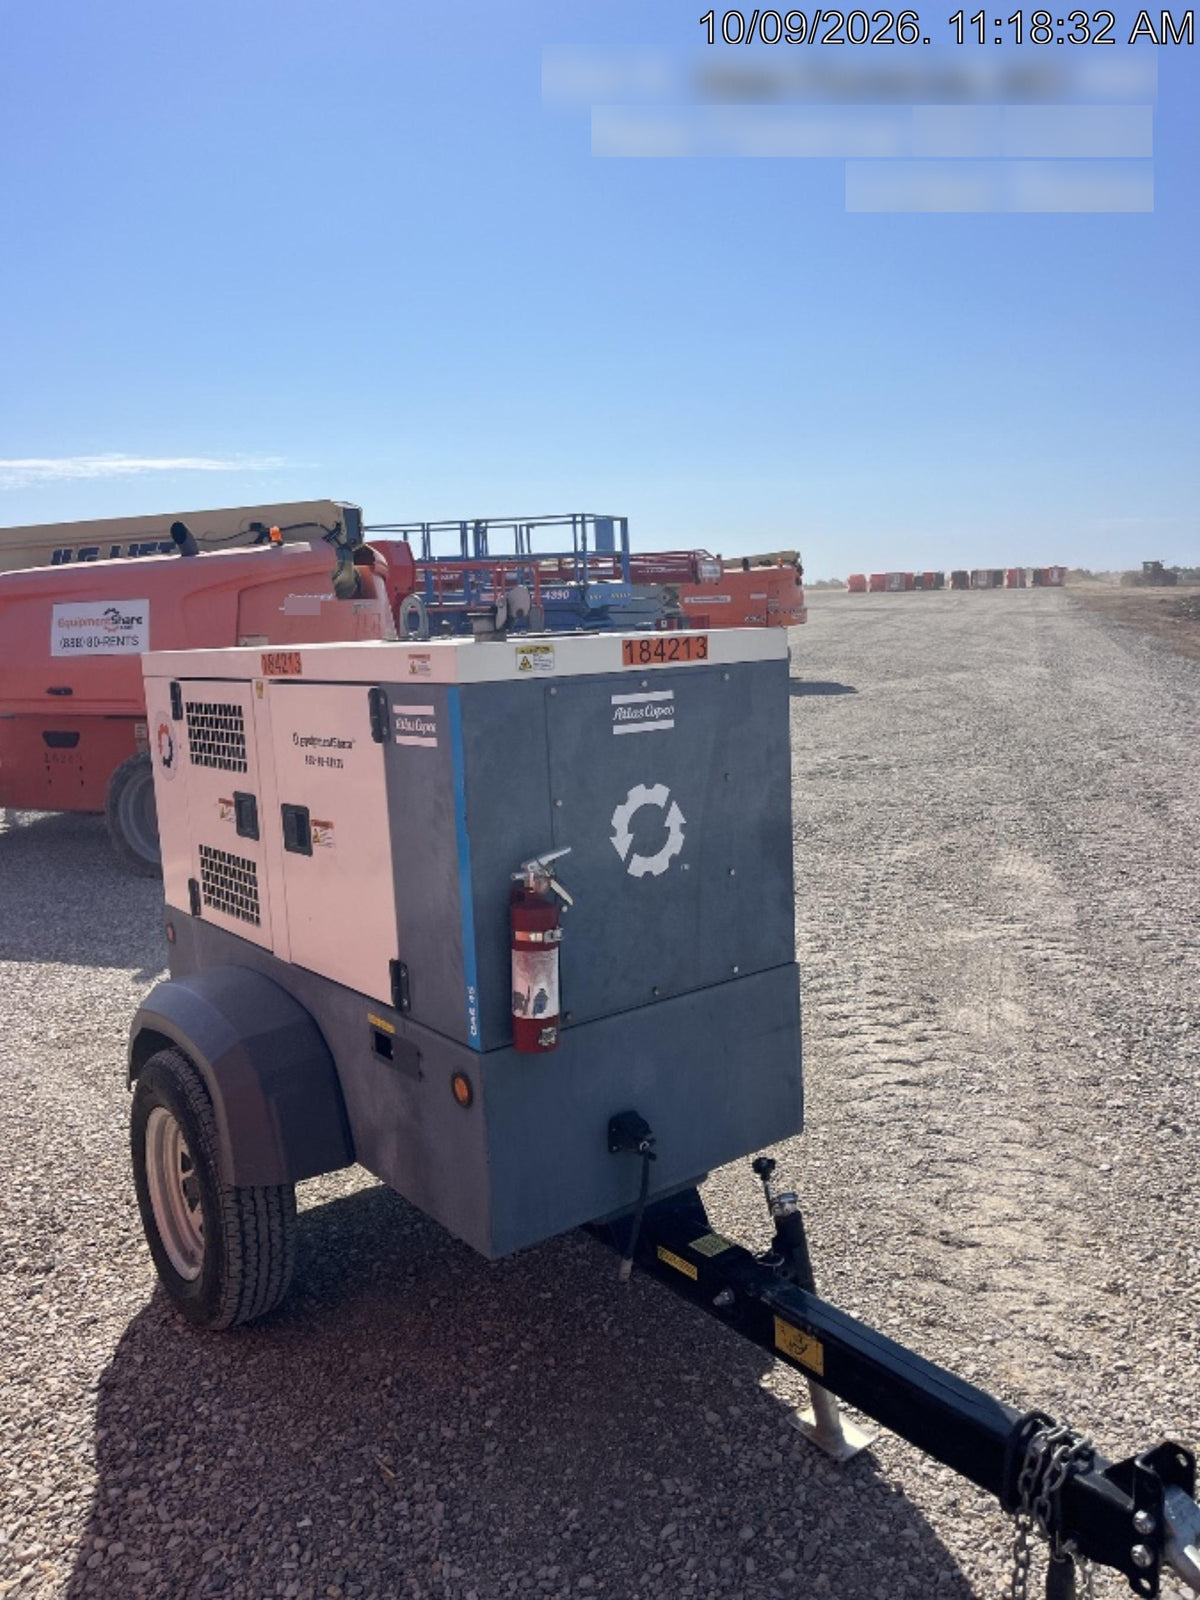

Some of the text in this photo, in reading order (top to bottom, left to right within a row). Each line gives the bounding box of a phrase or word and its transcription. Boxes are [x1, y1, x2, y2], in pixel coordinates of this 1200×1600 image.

[625, 635, 707, 664] 184213
[262, 653, 302, 674] 184213
[613, 704, 674, 720] Atlas Copco
